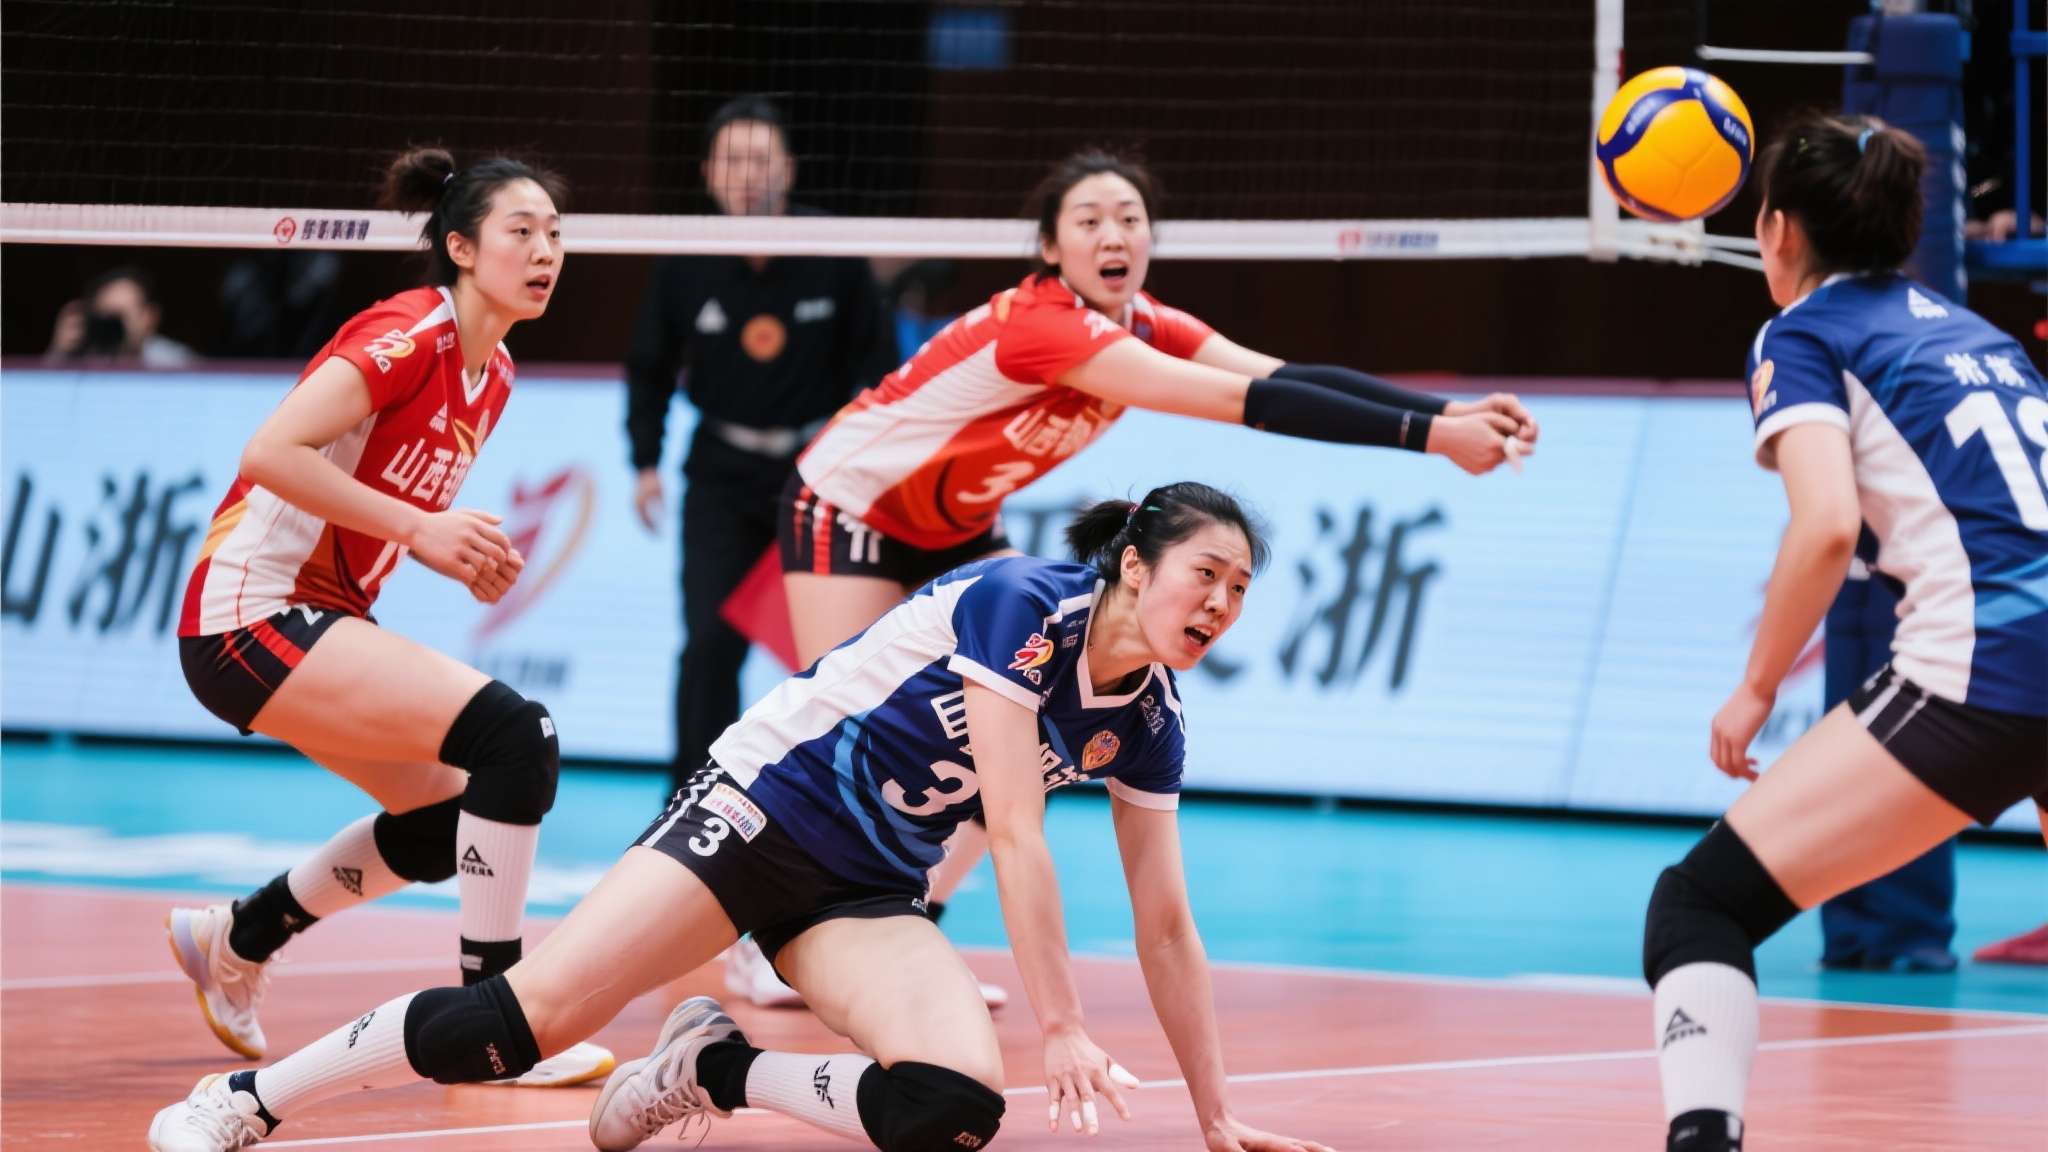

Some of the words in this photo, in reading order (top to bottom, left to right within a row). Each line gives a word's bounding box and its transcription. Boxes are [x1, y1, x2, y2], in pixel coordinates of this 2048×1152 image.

[956, 460, 1035, 503] 3
[880, 759, 980, 817] 3
[688, 816, 730, 857] 3
